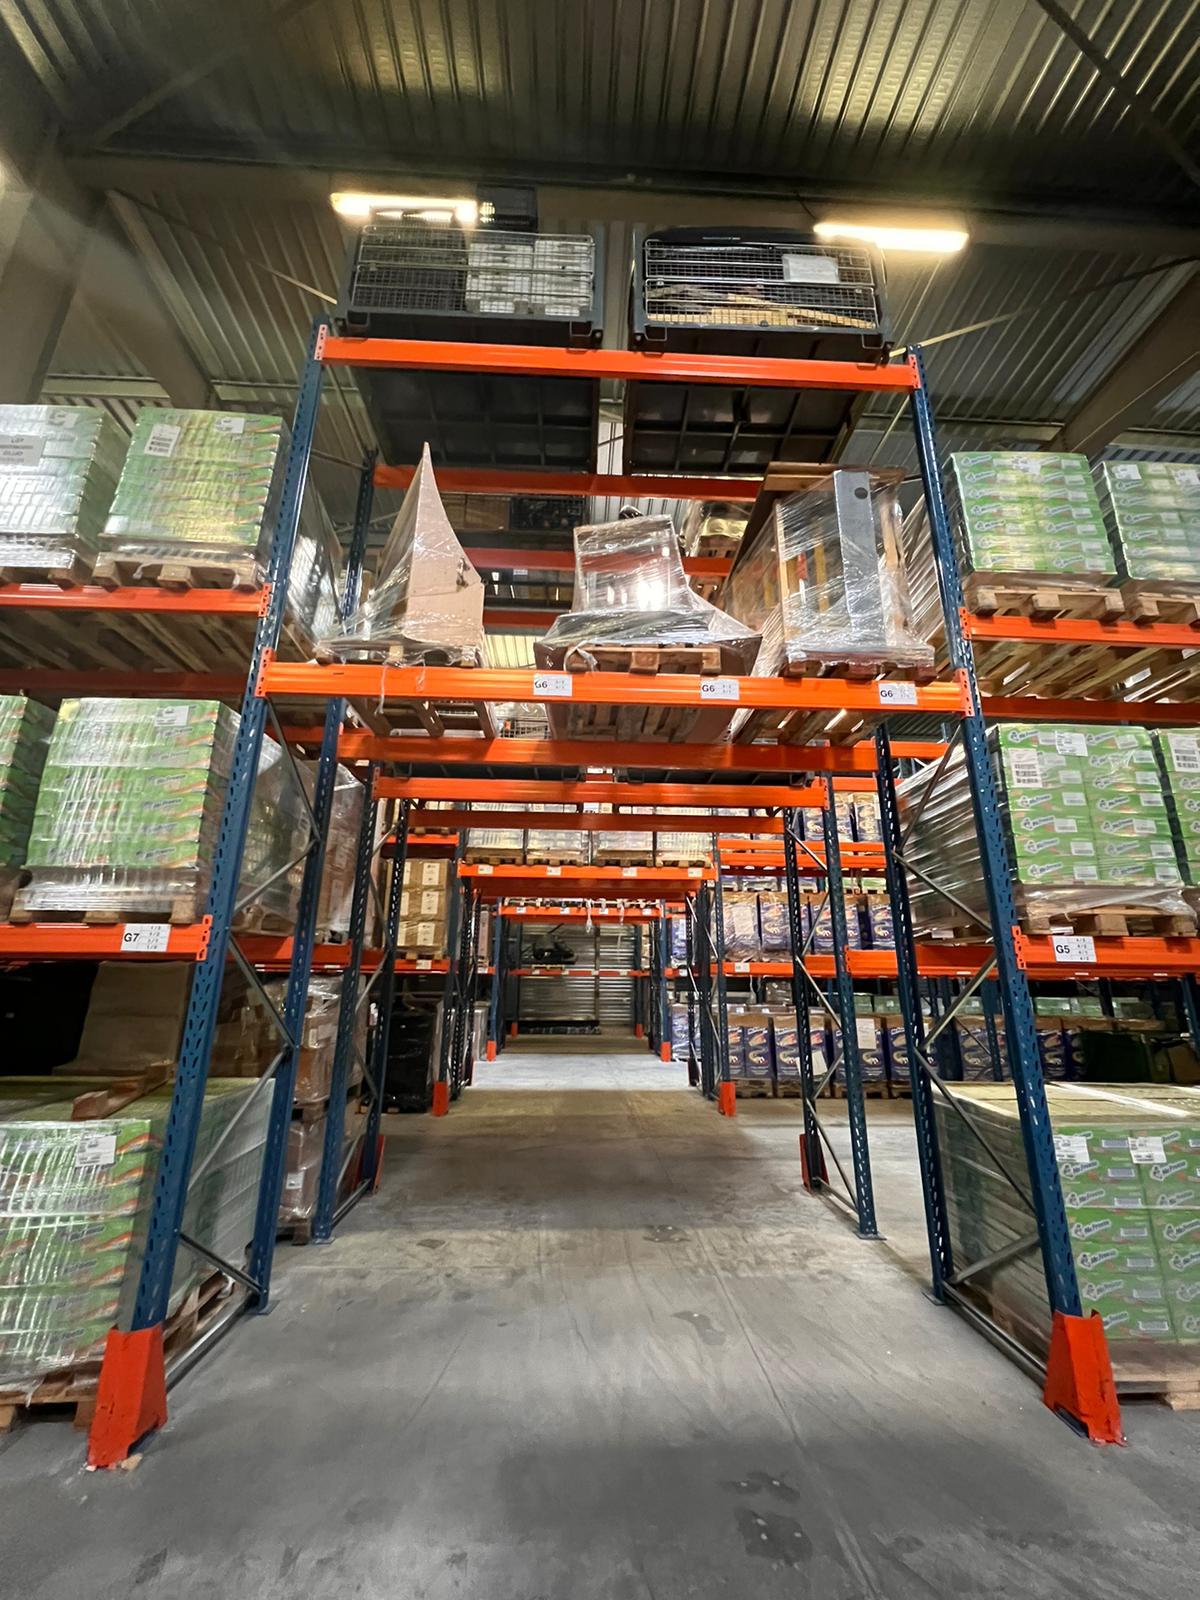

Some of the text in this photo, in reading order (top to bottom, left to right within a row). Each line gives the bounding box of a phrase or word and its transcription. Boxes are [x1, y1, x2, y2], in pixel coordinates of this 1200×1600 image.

[534, 679, 548, 689] G6
[702, 684, 715, 692] G6
[880, 689, 893, 698] G6
[124, 932, 140, 942] G7
[1056, 944, 1070, 954] G5
